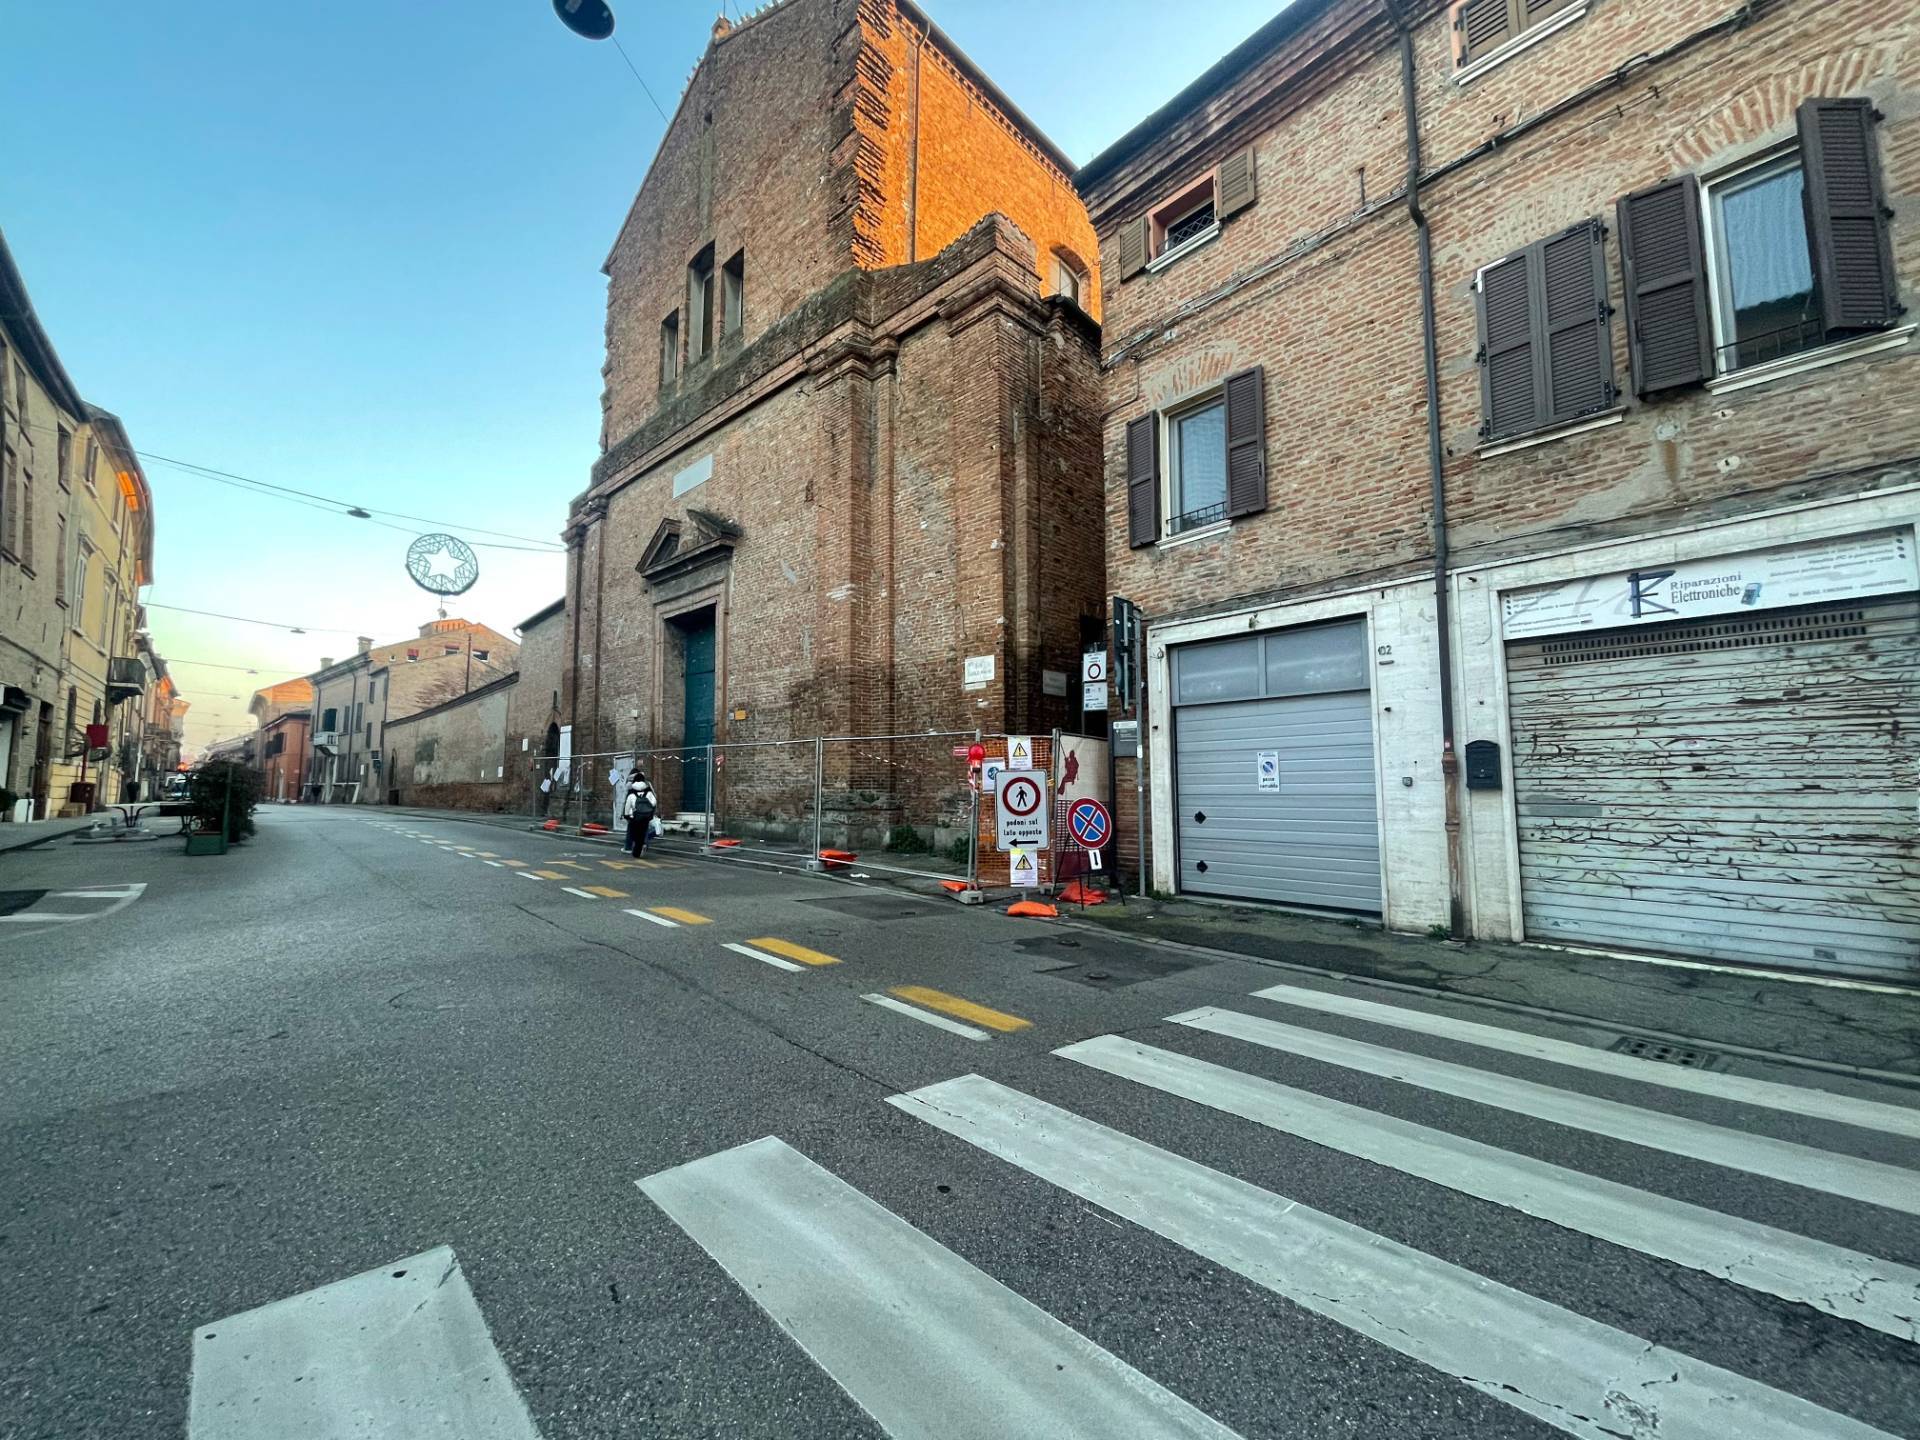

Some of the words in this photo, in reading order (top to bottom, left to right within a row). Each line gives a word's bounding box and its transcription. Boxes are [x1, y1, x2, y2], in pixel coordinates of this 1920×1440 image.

[1670, 571, 1742, 591] Riparazioni
[1671, 583, 1741, 605] Elettroniche
[1006, 818, 1027, 828] pedoni
[1028, 818, 1039, 826] sul
[1018, 829, 1042, 837] opposto
